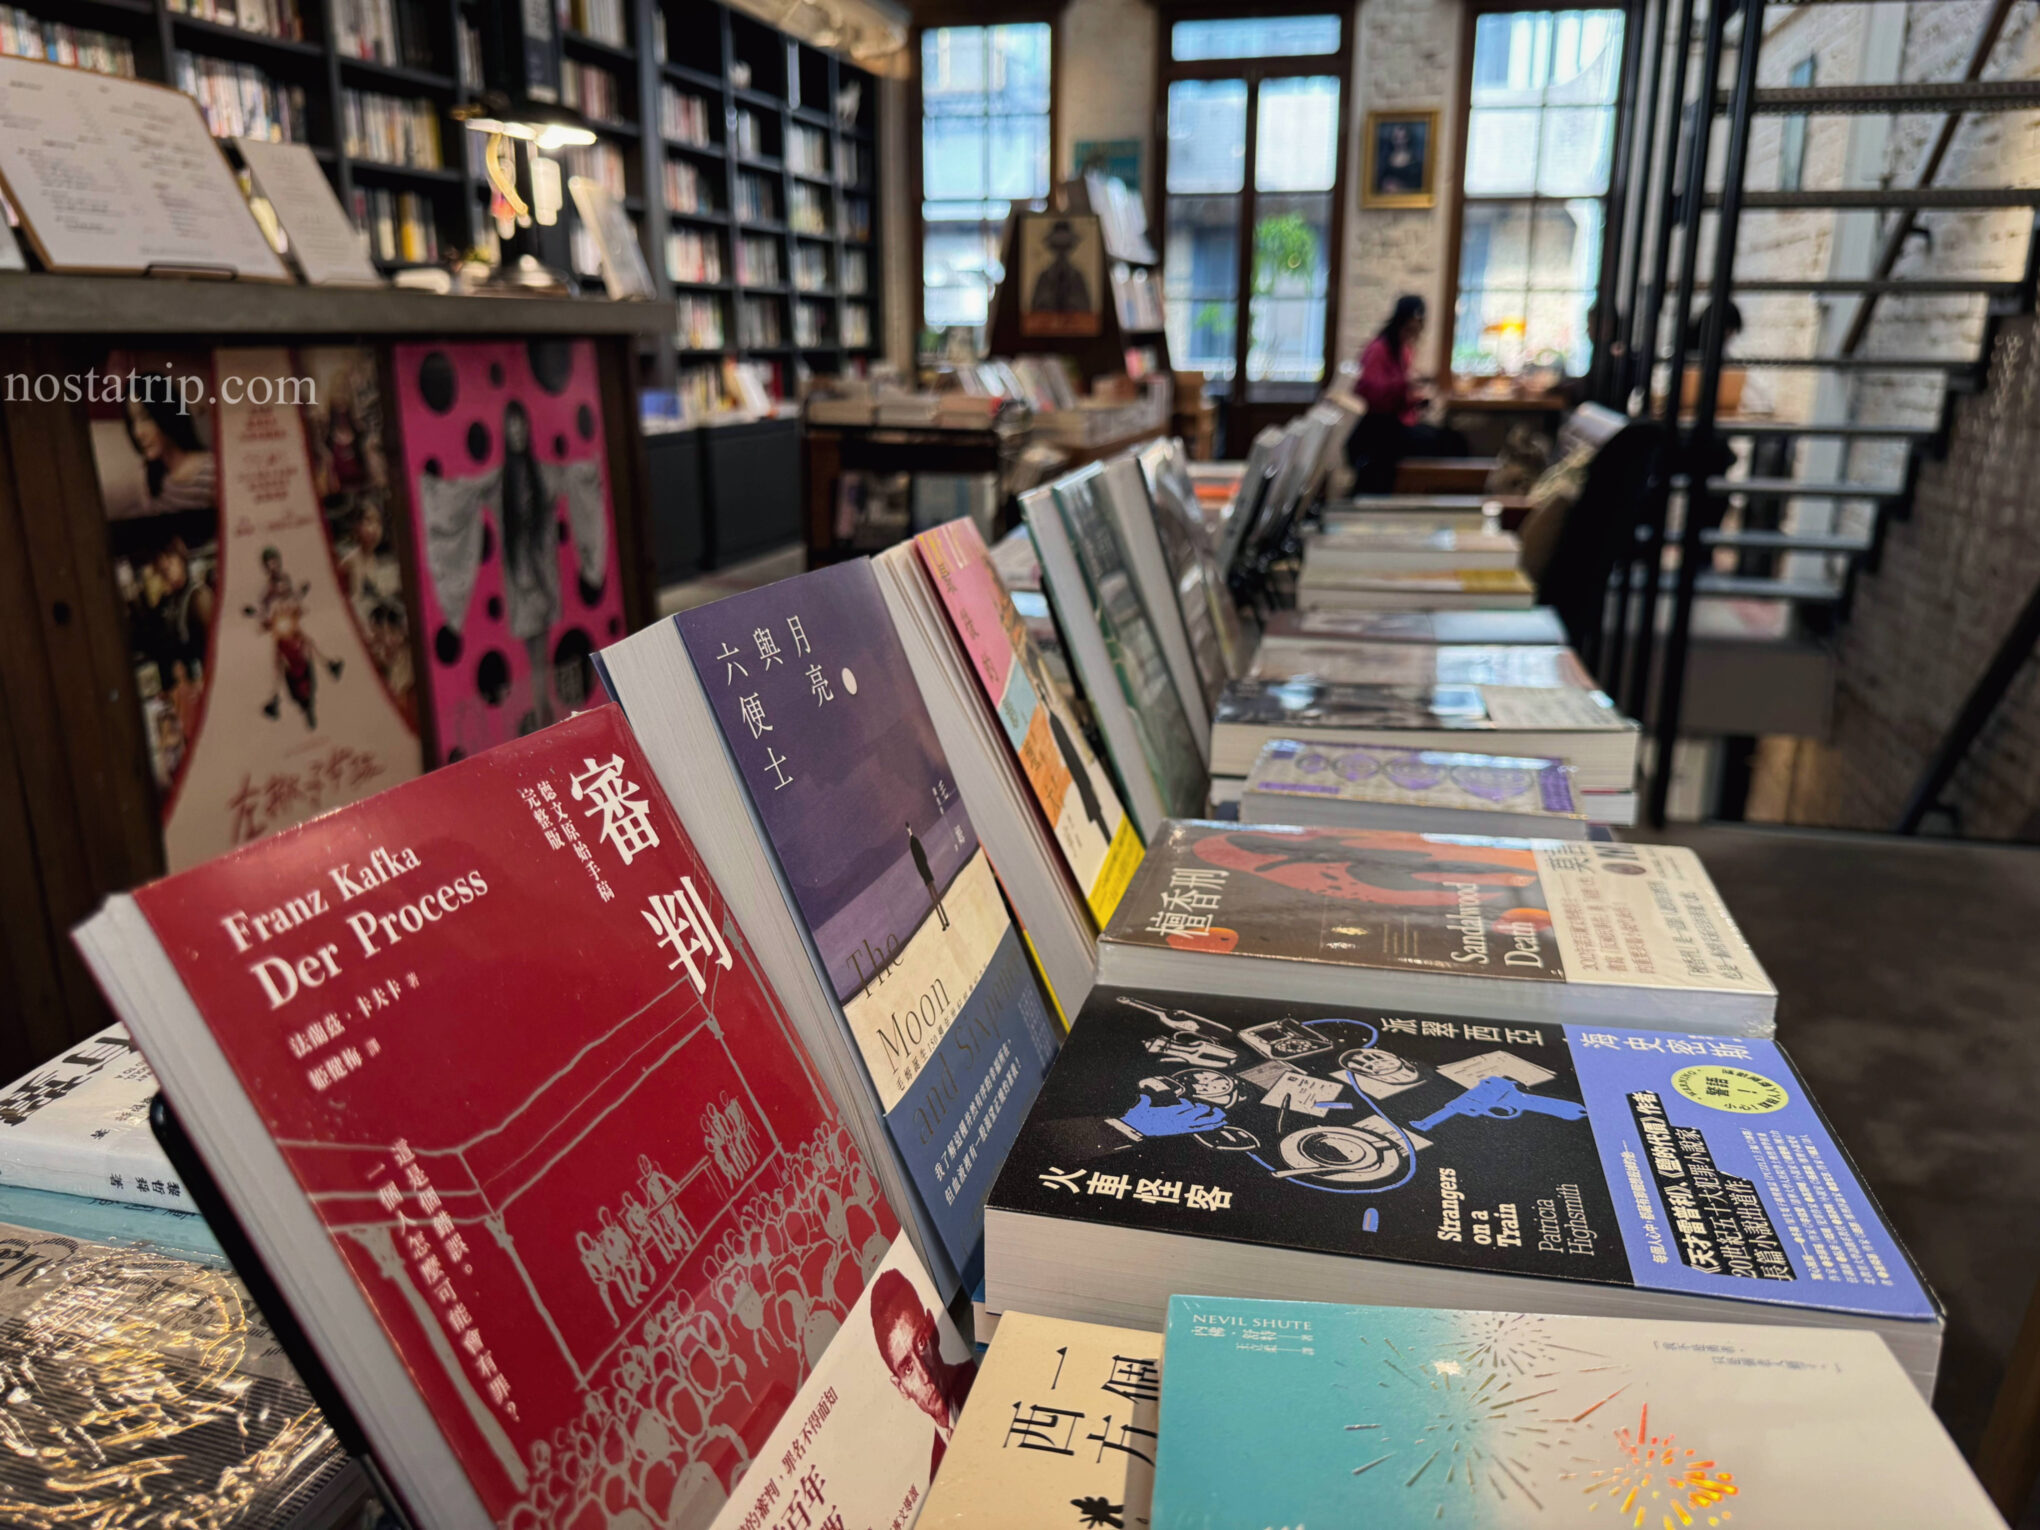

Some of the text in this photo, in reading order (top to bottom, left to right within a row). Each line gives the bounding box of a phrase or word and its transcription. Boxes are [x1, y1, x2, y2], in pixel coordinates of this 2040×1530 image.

[752, 627, 783, 671] 與
[786, 615, 834, 708] 月亮
[716, 642, 793, 791] 六便士
[519, 787, 566, 851] 完整版
[536, 780, 615, 903] 德文原始手稿
[221, 845, 422, 953] Franz Kafka
[569, 753, 733, 995] 審判
[1146, 867, 1231, 941] 檀香刑
[250, 869, 489, 1011] Der Process
[1446, 881, 1490, 965] Sandalwood
[1496, 921, 1544, 969] Death
[847, 932, 905, 999] The
[876, 977, 952, 1075] Moon
[912, 1053, 960, 1145] and
[1038, 1166, 1233, 1212] 火車怪客
[1437, 1167, 1465, 1243] Strangers
[1493, 1203, 1522, 1248] Train
[1532, 1198, 1564, 1254] Patricia
[1555, 1183, 1598, 1257] Highsmith
[1471, 1221, 1492, 1246] on
[1192, 1313, 1313, 1331] NEVIL SHUTE
[739, 1386, 838, 1530] 的審判，罪名不得而知
